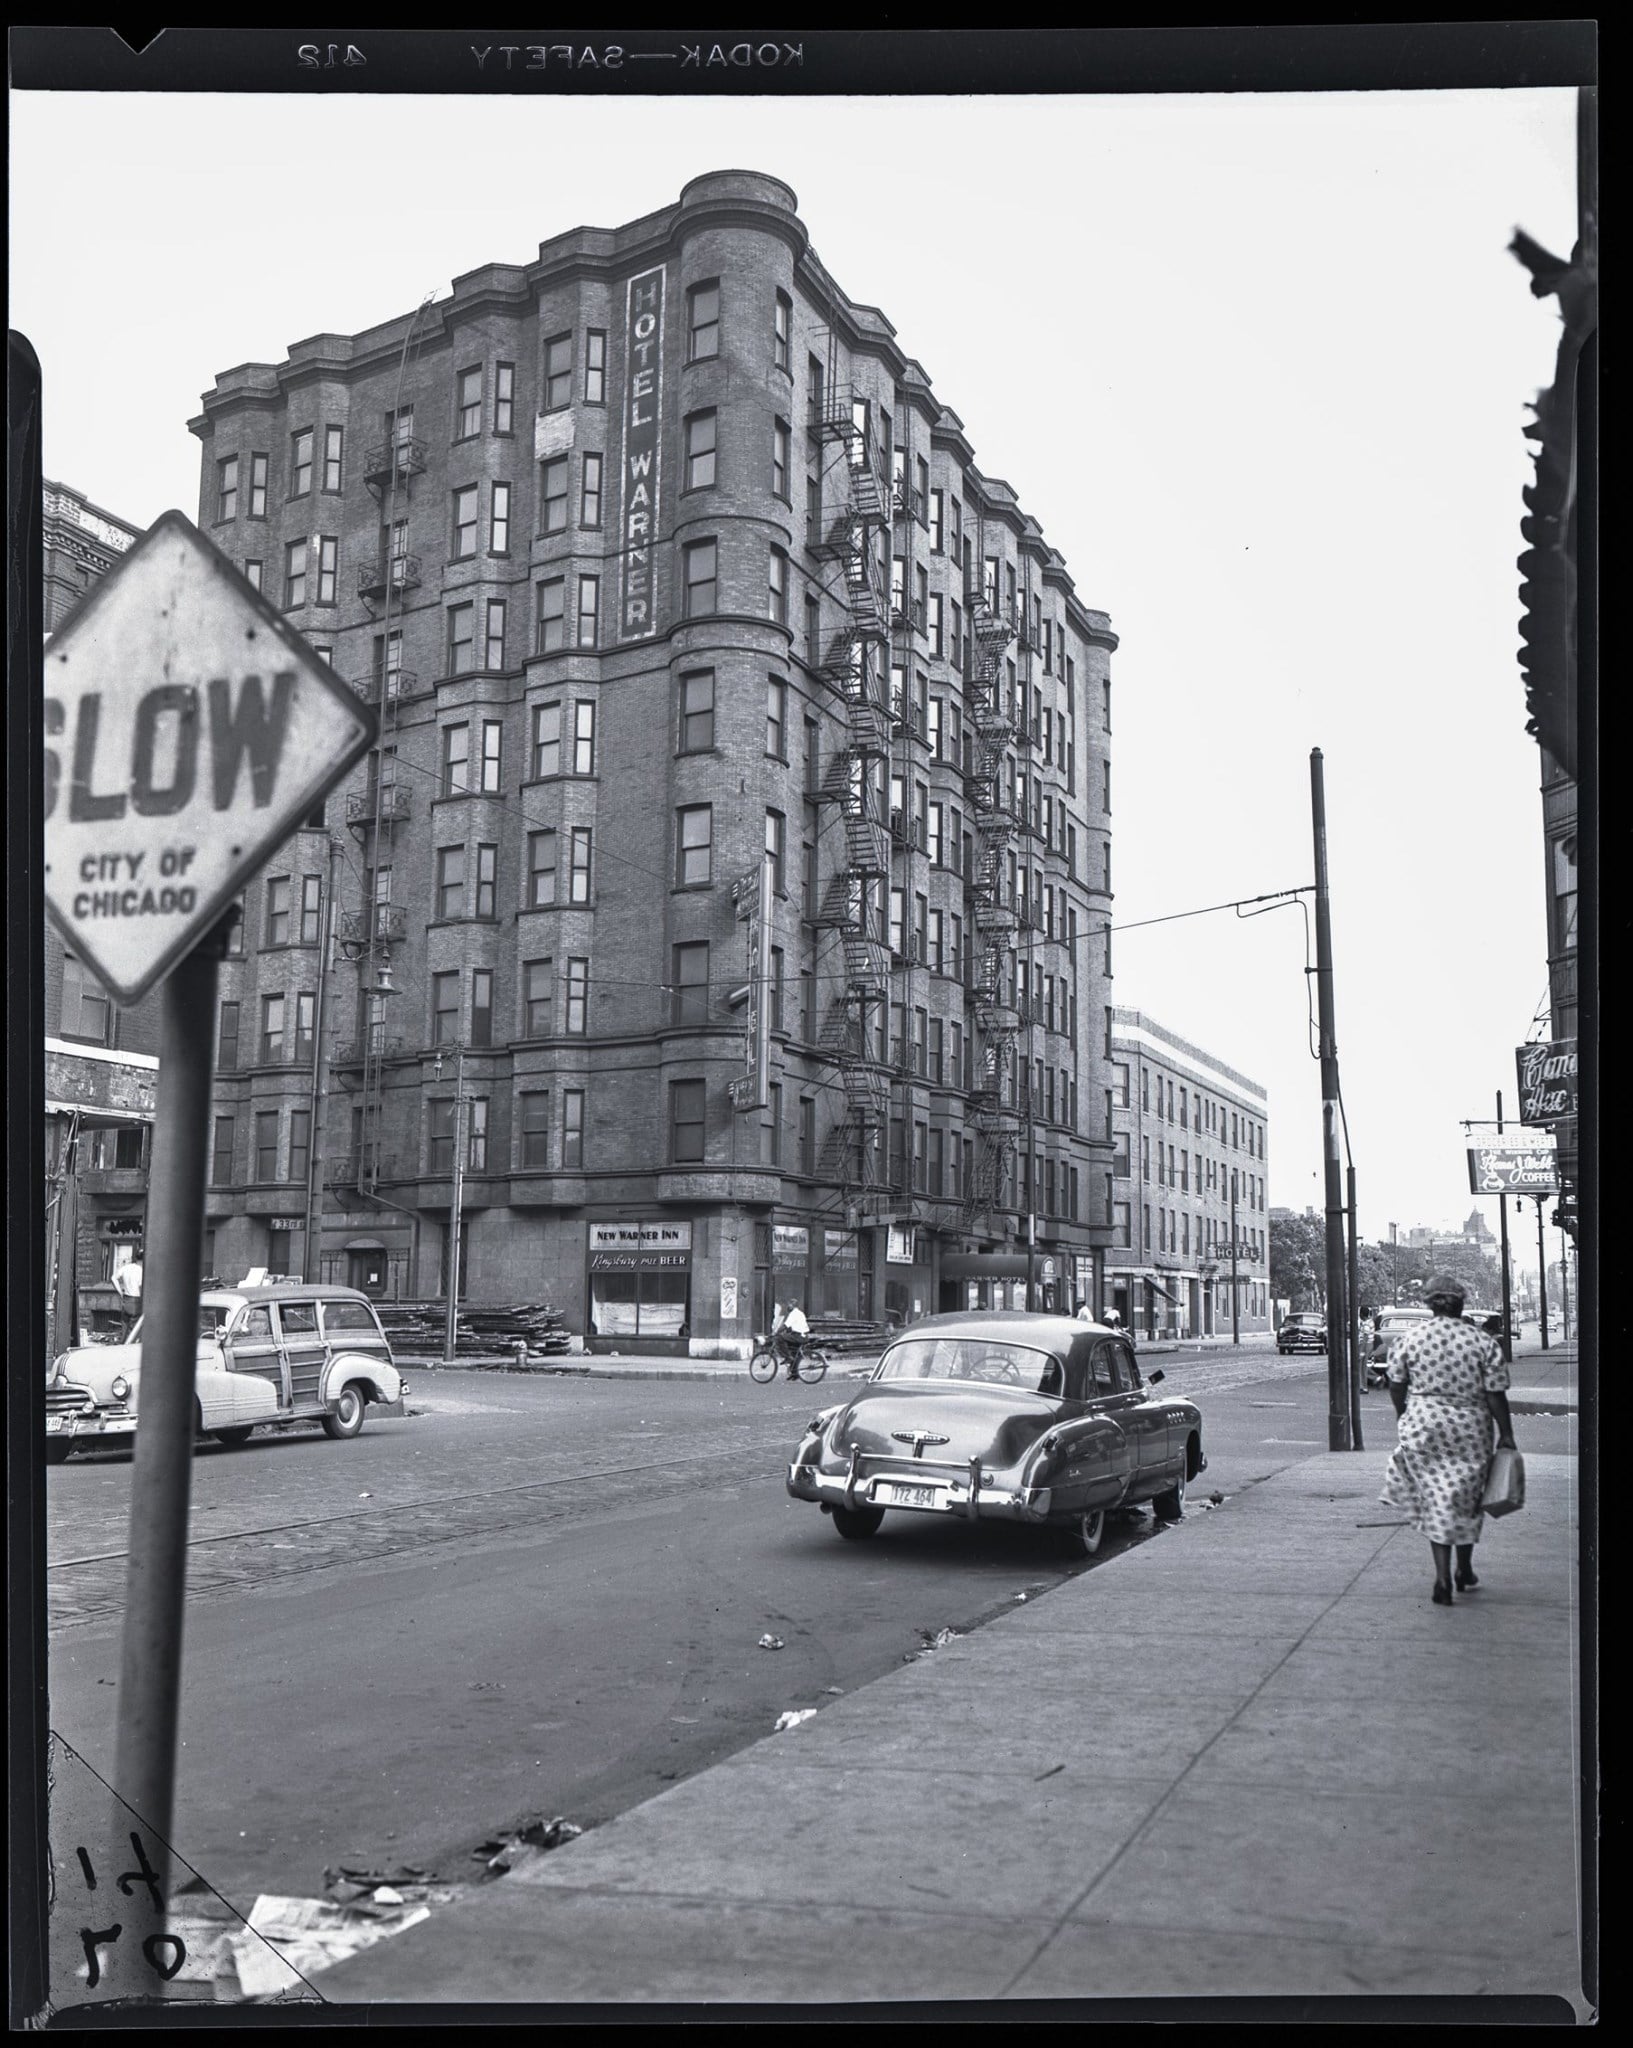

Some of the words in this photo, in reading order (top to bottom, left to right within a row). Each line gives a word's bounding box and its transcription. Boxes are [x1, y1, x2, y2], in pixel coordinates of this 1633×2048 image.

[632, 280, 658, 428] HOTEL
[626, 449, 653, 627] WARNER
[79, 851, 145, 883] CITY
[159, 849, 197, 878] OF
[74, 886, 197, 920] CHICAGO
[1521, 1172, 1556, 1183] COFFEE
[597, 1230, 617, 1241] NEW
[618, 1230, 659, 1241] WARNER
[661, 1229, 680, 1240] INN
[591, 1253, 638, 1270] Kingsbury
[660, 1255, 686, 1265] BEER
[1217, 1248, 1258, 1258] HOTEL
